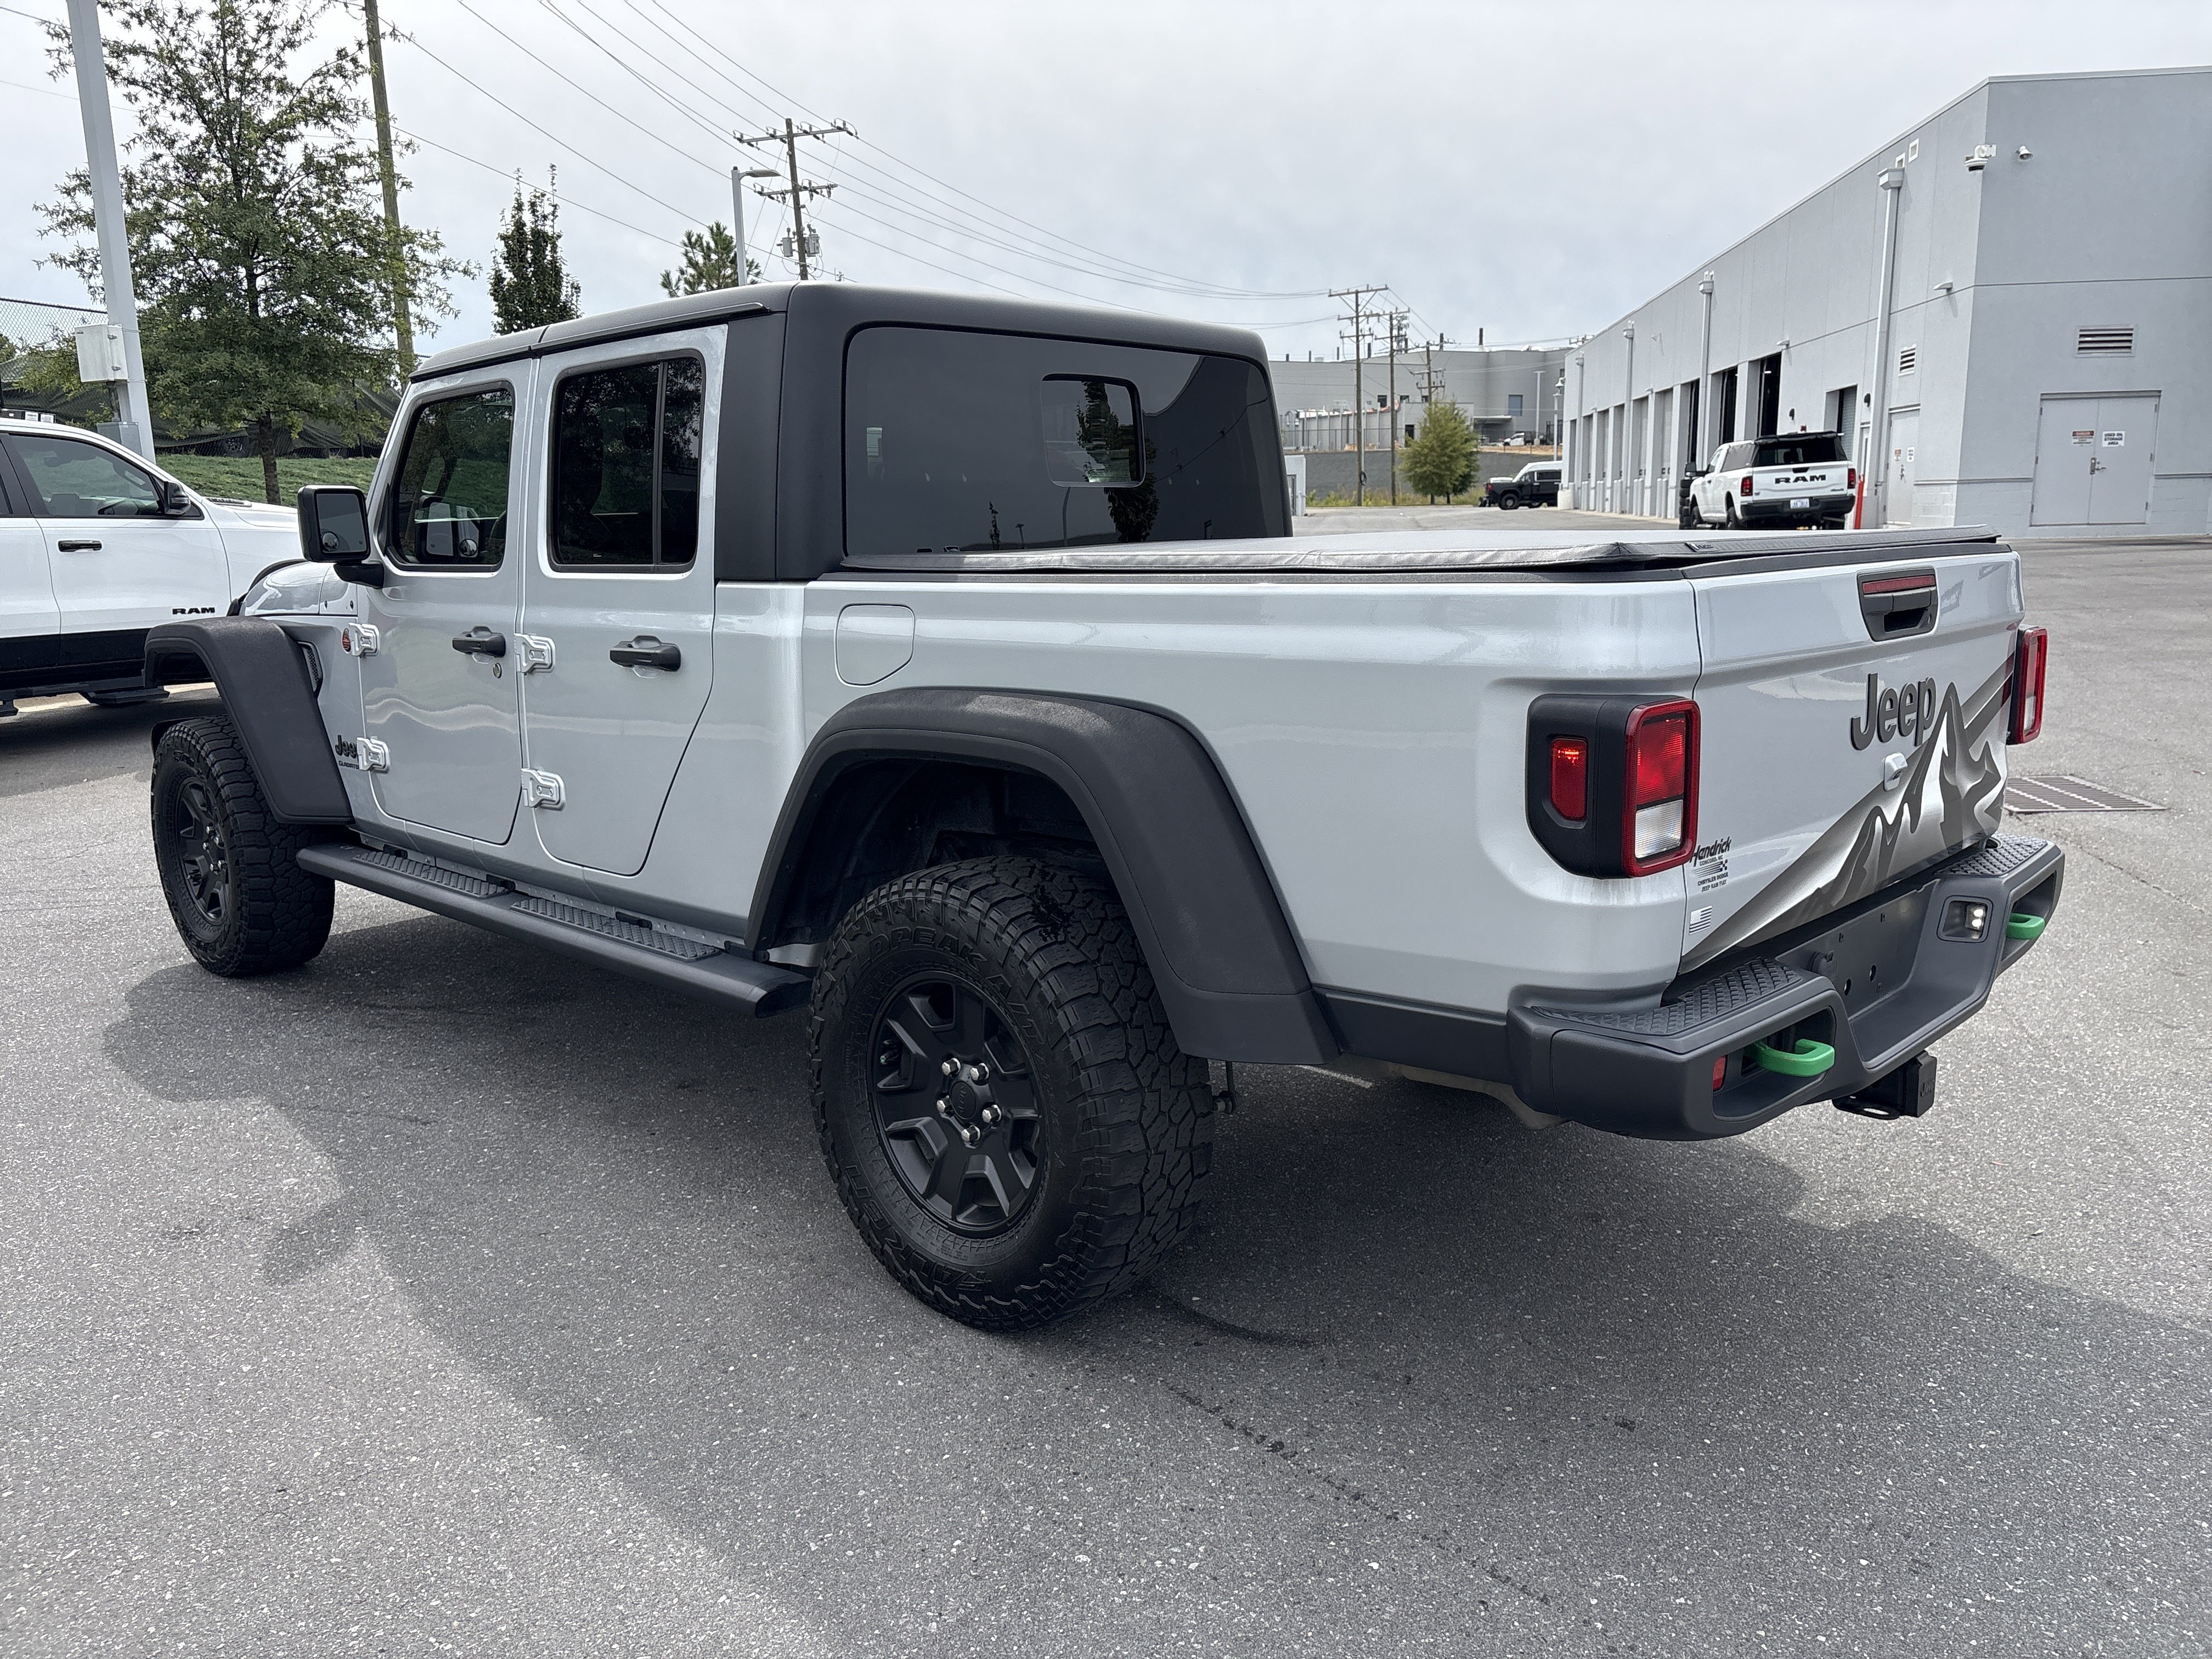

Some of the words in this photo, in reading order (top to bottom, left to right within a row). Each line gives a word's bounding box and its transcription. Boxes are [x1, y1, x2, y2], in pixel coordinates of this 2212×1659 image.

[1775, 475, 1826, 484] RAM
[1850, 673, 1937, 751] Jeep
[335, 735, 358, 759] Jee
[338, 760, 359, 769] GLADIATO
[1689, 836, 1732, 867] Hendrick
[1697, 876, 1716, 886] CHRYSLER
[1717, 872, 1729, 881] DODGE
